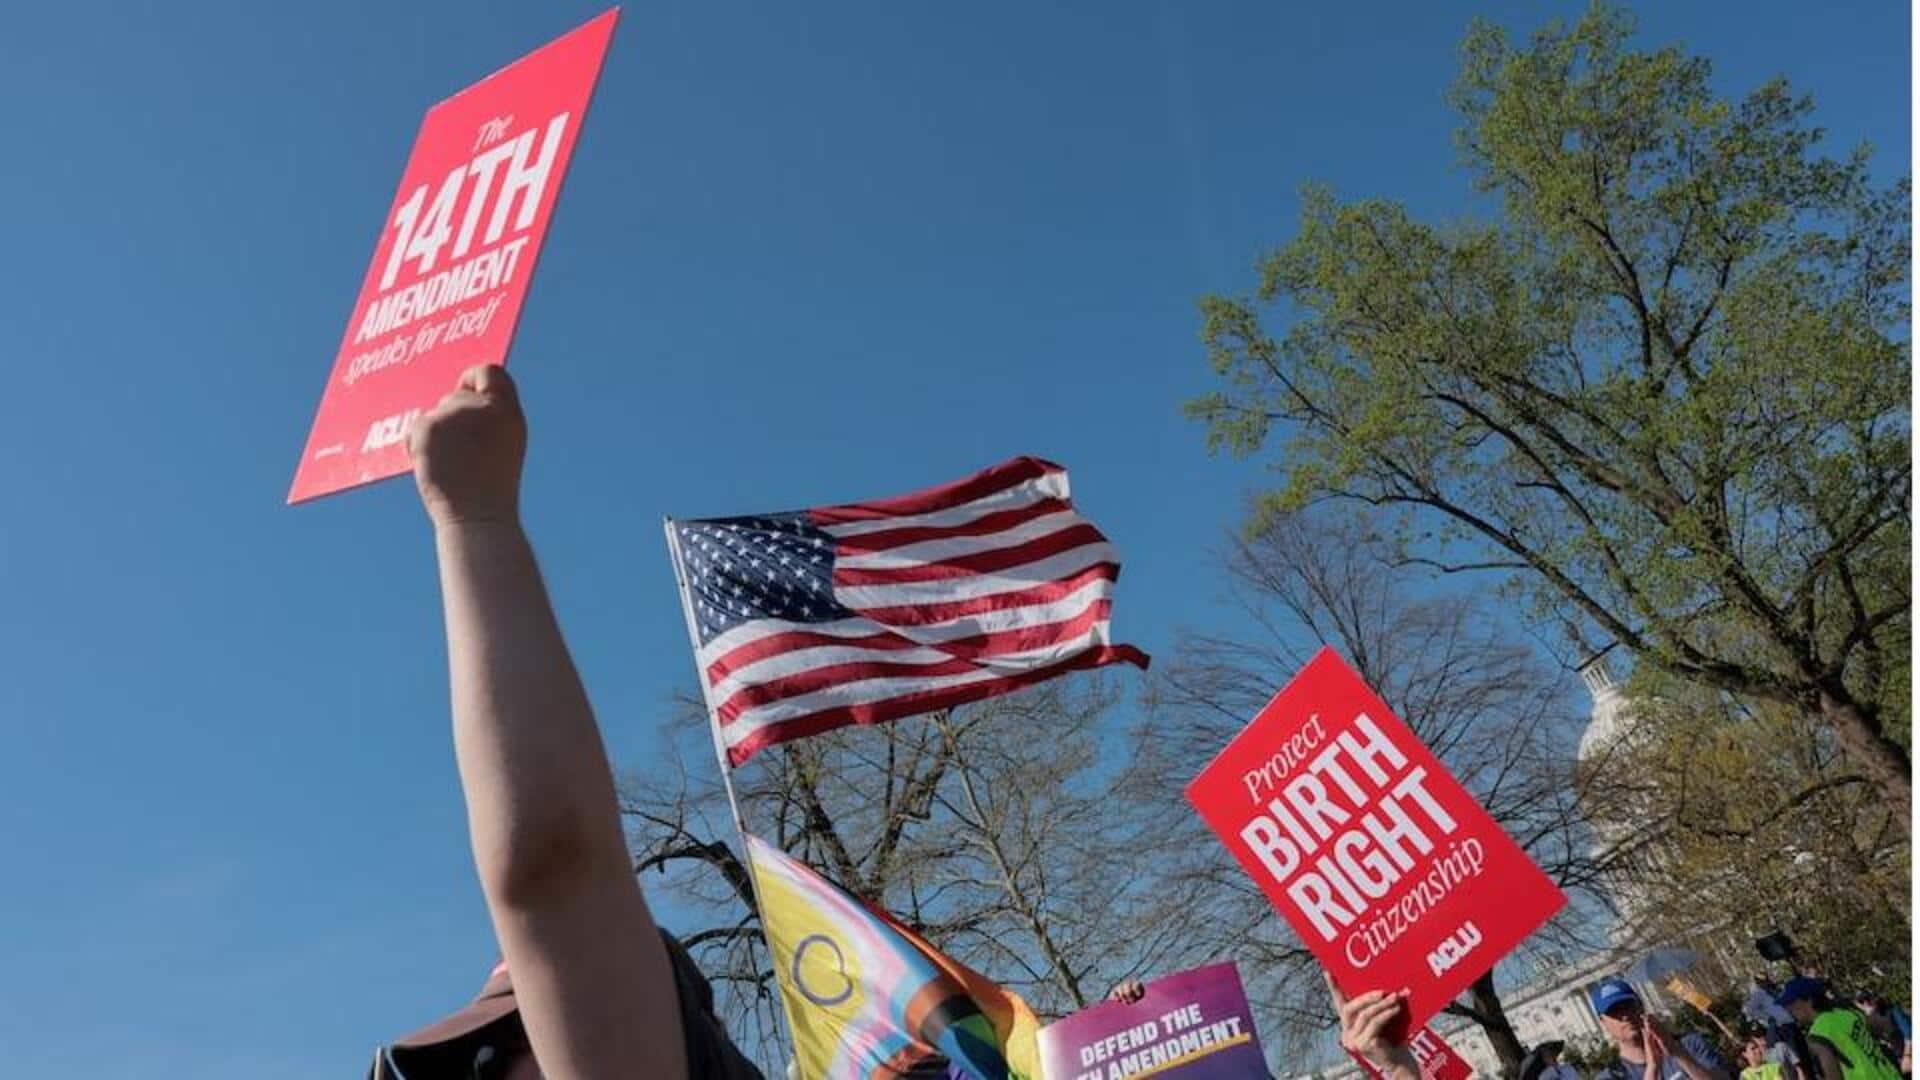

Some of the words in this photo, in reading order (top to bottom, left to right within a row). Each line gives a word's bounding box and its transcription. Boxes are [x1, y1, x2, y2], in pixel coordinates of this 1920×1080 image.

[473, 113, 514, 153] The
[379, 112, 569, 291] 14TH
[355, 237, 528, 346] AMENDMENT
[404, 321, 446, 365] for
[442, 292, 508, 344] itself
[1239, 712, 1409, 883] BIRTH
[1243, 713, 1327, 807] Protect
[1287, 766, 1458, 943] RIGHT
[1345, 837, 1484, 968] Citizenship
[1426, 919, 1483, 978] ACLU
[1080, 1020, 1159, 1069] DEFEND
[1160, 1002, 1204, 1035] THE
[1108, 1016, 1241, 1080] AMENDMENT
